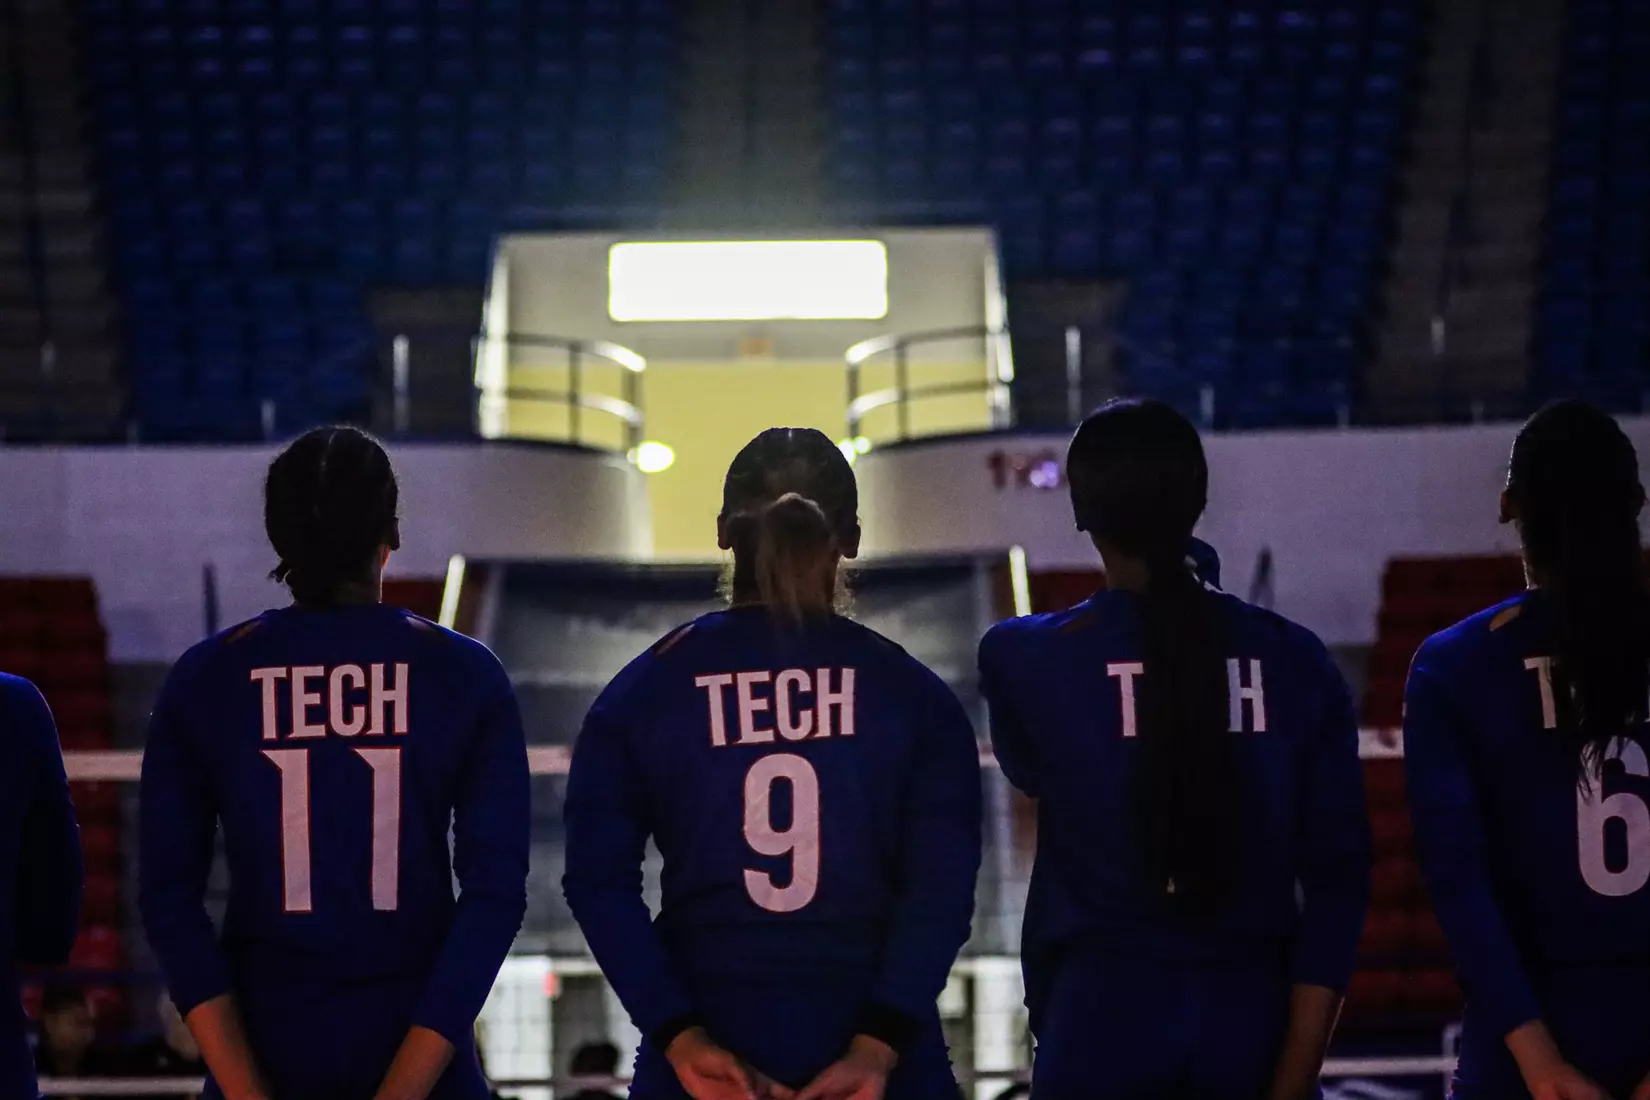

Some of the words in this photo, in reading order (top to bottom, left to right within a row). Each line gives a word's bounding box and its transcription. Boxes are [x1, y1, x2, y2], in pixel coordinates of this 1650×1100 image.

[249, 661, 410, 741] TECH
[694, 666, 857, 748] TECH
[1105, 656, 1268, 738] TH
[259, 746, 402, 914] 11
[742, 751, 821, 913] 9
[1575, 734, 1650, 898] 6
